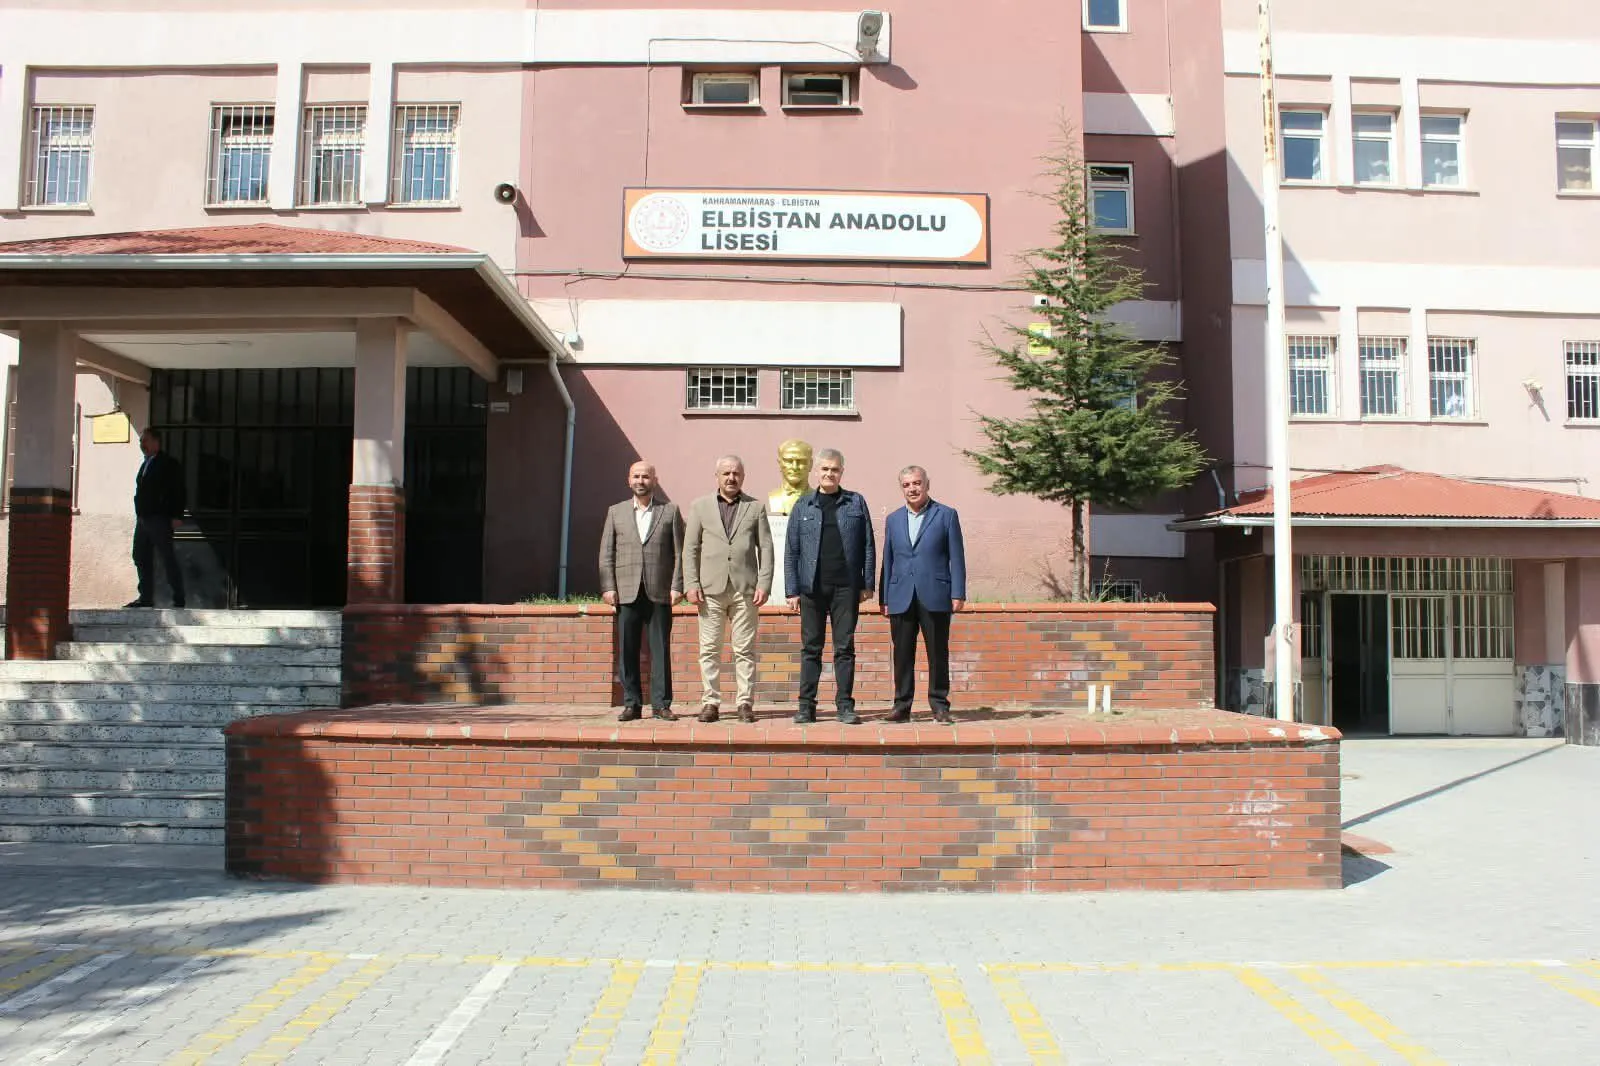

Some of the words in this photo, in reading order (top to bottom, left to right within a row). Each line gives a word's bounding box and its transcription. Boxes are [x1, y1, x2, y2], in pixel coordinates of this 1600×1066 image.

[702, 207, 821, 228] ELBİSTAN
[829, 212, 946, 232] ANADOLU
[701, 229, 778, 251] LİSESİ
